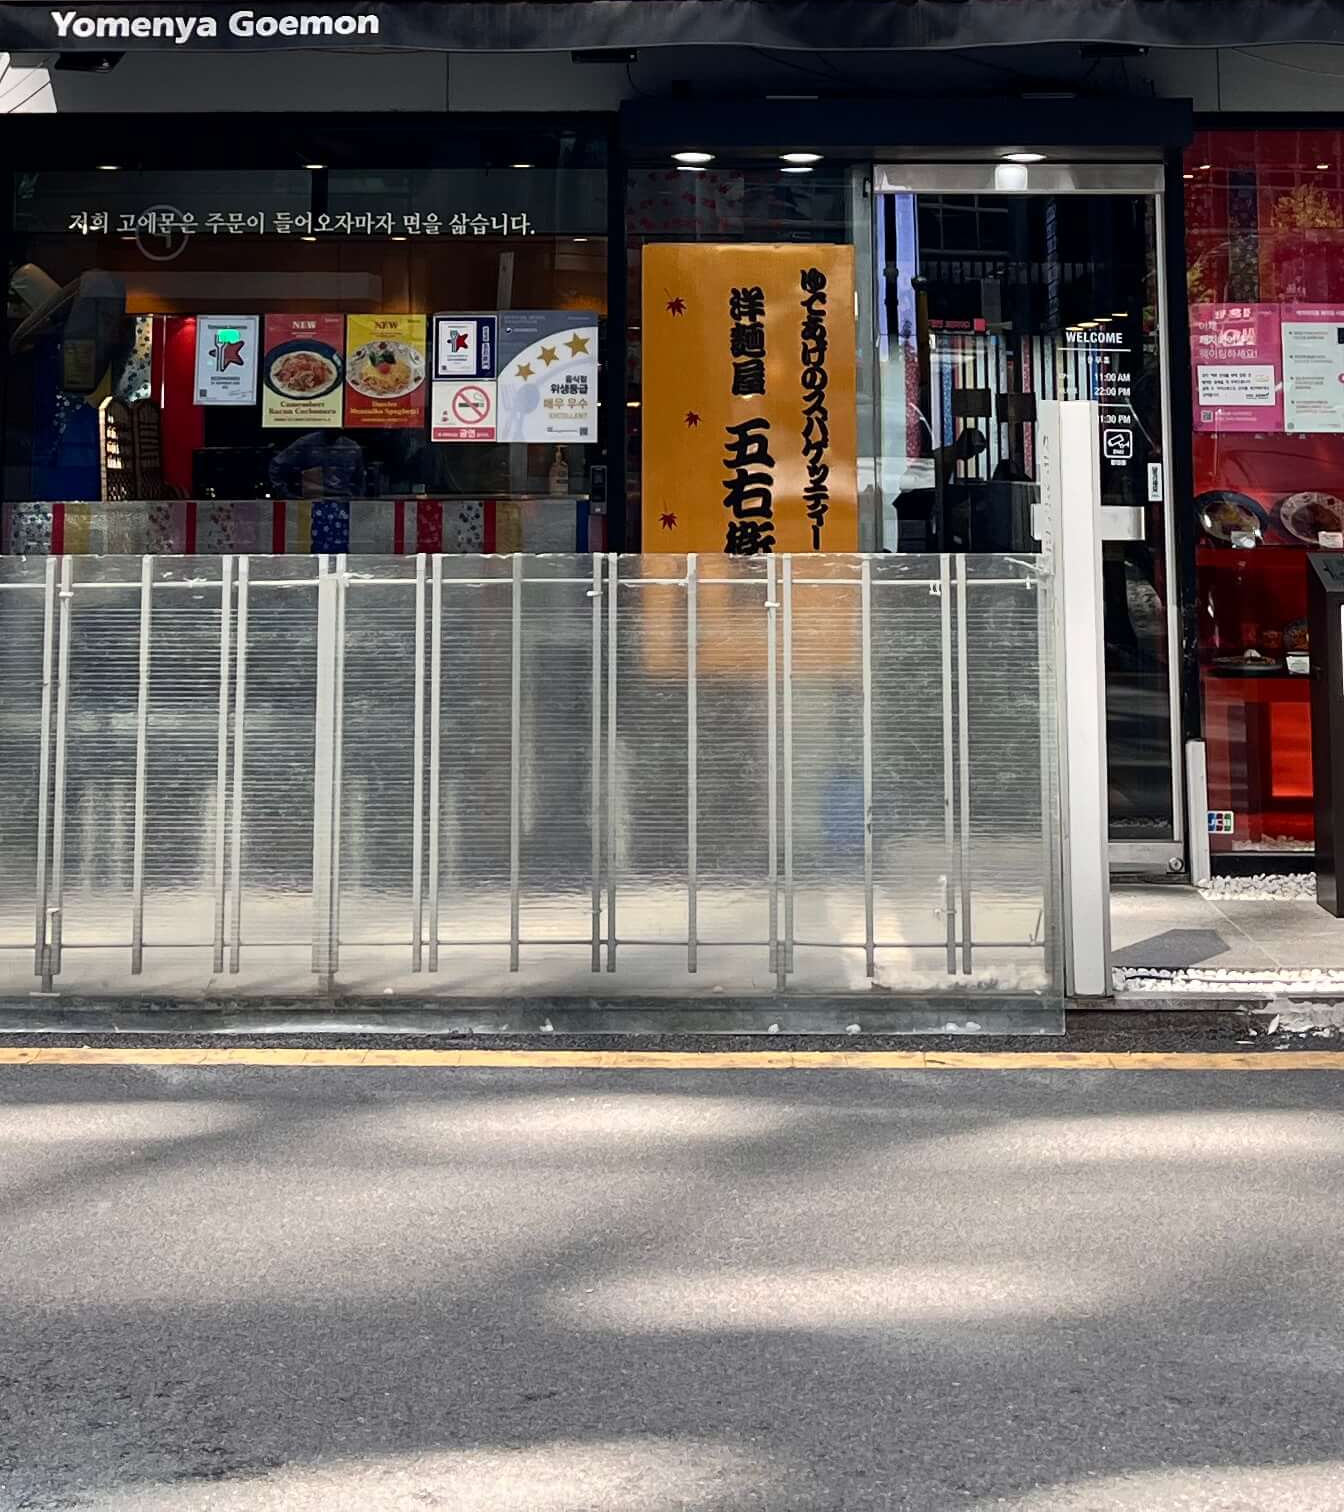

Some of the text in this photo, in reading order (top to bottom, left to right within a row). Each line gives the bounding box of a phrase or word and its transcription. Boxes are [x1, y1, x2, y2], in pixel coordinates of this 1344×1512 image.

[50, 10, 380, 44] Yomenya Goemon
[68, 211, 536, 236] 저희 고에몬은 주문이 들어오자마자 면을 삶습니다.
[292, 320, 317, 329] NEW
[374, 320, 399, 329] NEW
[1065, 331, 1123, 344] WELCOME
[1094, 373, 1131, 382] 11:00 AM
[550, 384, 588, 395] 위생등급
[1094, 387, 1131, 397] 22:00 PM
[567, 398, 588, 409] 우수
[1118, 415, 1131, 424] PM
